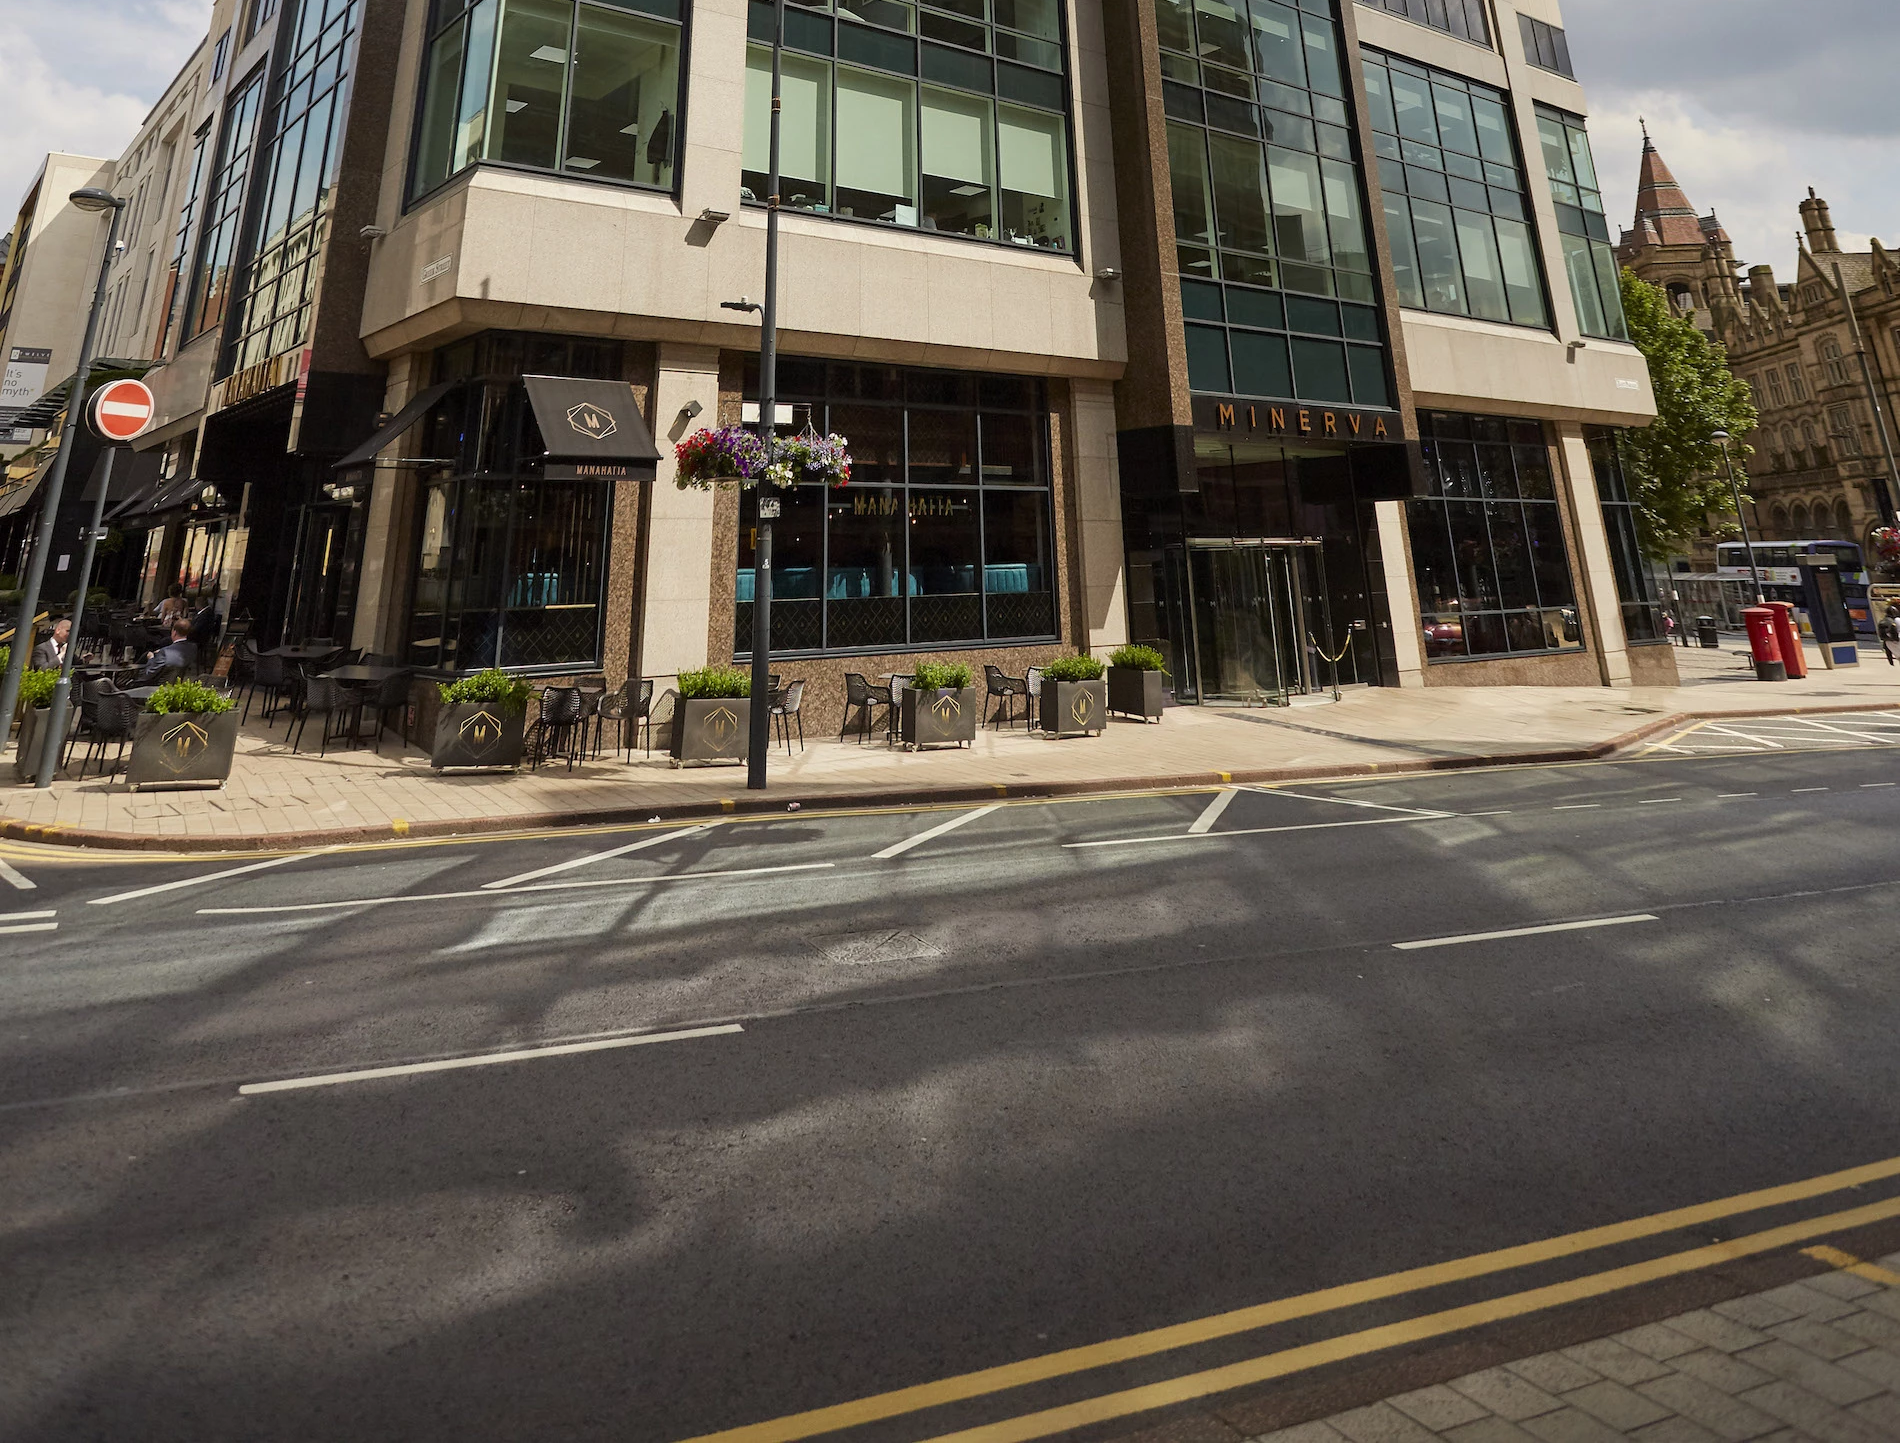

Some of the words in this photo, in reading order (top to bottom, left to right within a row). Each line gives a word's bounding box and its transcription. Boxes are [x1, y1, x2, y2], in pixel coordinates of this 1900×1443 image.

[4, 378, 18, 387] no
[584, 412, 600, 429] M
[1218, 402, 1388, 437] MINERVA
[576, 464, 627, 476] MANAHATTA
[473, 724, 487, 744] M
[176, 736, 191, 757] M
